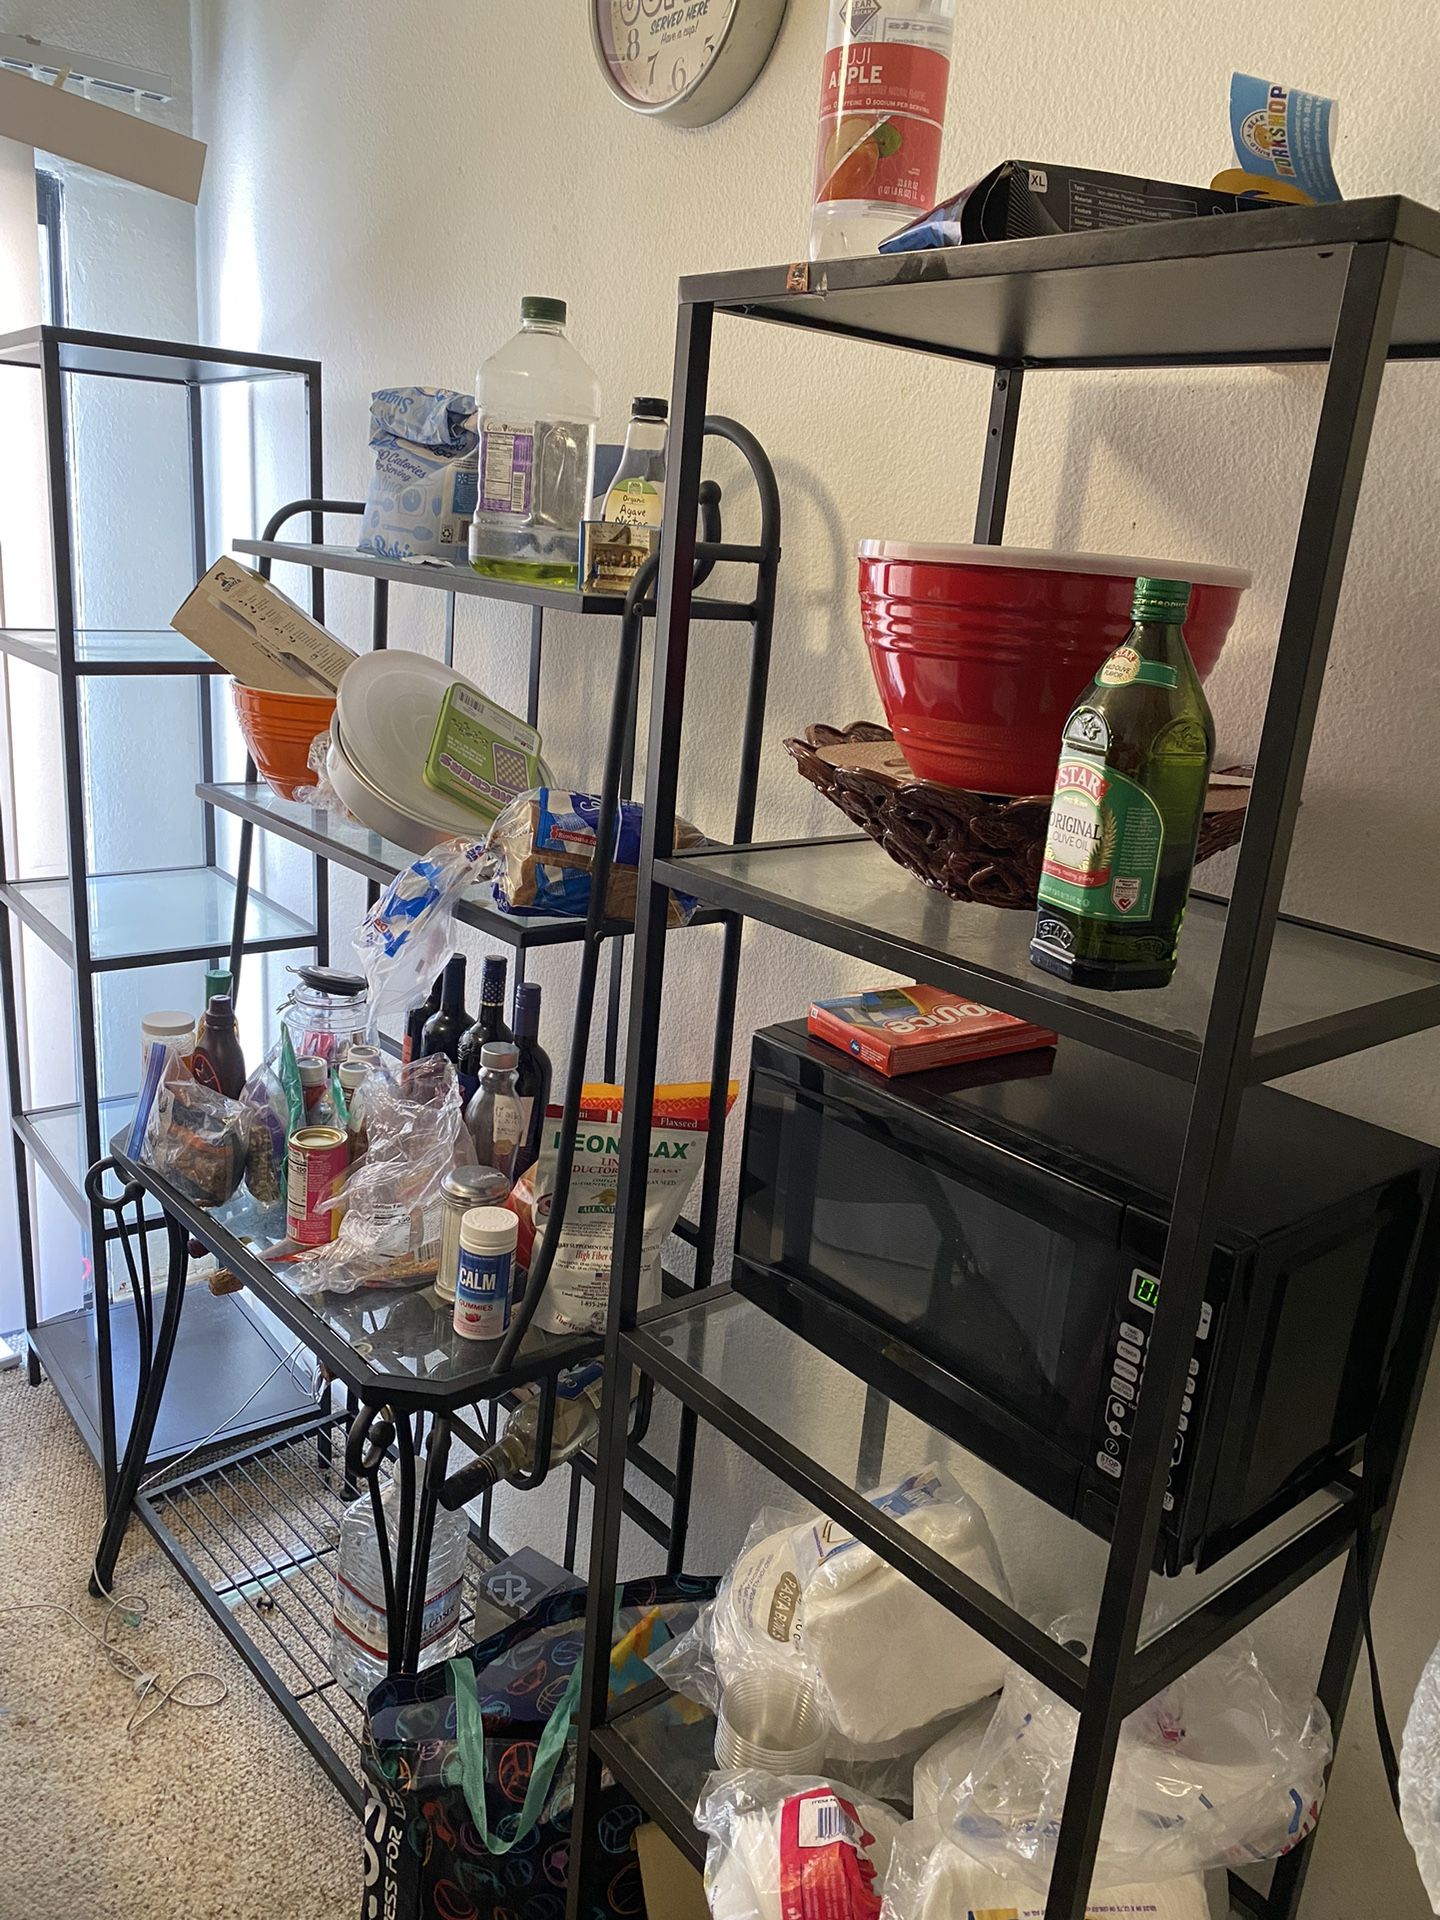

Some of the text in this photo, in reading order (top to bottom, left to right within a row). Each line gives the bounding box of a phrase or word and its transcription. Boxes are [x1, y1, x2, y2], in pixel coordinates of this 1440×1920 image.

[650, 11, 683, 35] SERVED
[685, 2, 709, 20] HERE
[626, 28, 640, 61] 8
[661, 31, 676, 45] Have
[683, 22, 699, 38] cup!
[647, 51, 660, 85] 7
[671, 56, 687, 91] 6
[829, 66, 883, 89] APLE
[866, 98, 871, 107] 0
[872, 99, 896, 107] SODIUM
[897, 101, 908, 109] PER
[1269, 85, 1295, 176] WORKSHOP
[1031, 174, 1046, 188] XL
[383, 463, 412, 482] Serving
[388, 450, 427, 479] Calories
[622, 494, 646, 504] Organic
[619, 504, 647, 518] Agave
[1115, 649, 1136, 662] STAR
[439, 753, 515, 804] HECKERS
[1059, 766, 1101, 797] STAR
[1049, 810, 1102, 842] ORIGINAL
[1052, 831, 1089, 852] OLIVE OIL
[1041, 920, 1069, 943] STAR
[889, 1002, 993, 1033] ounce
[660, 1117, 698, 1129] Flaxseed
[576, 1250, 608, 1261] High Fiber
[460, 1266, 496, 1290] CALM
[459, 1298, 493, 1311] GUMMIES
[1112, 1423, 1119, 1433] 4
[1109, 1441, 1116, 1451] 7
[1101, 1455, 1119, 1468] STOP
[776, 1576, 798, 1611] PASTA
[386, 1828, 403, 1873] FOR
